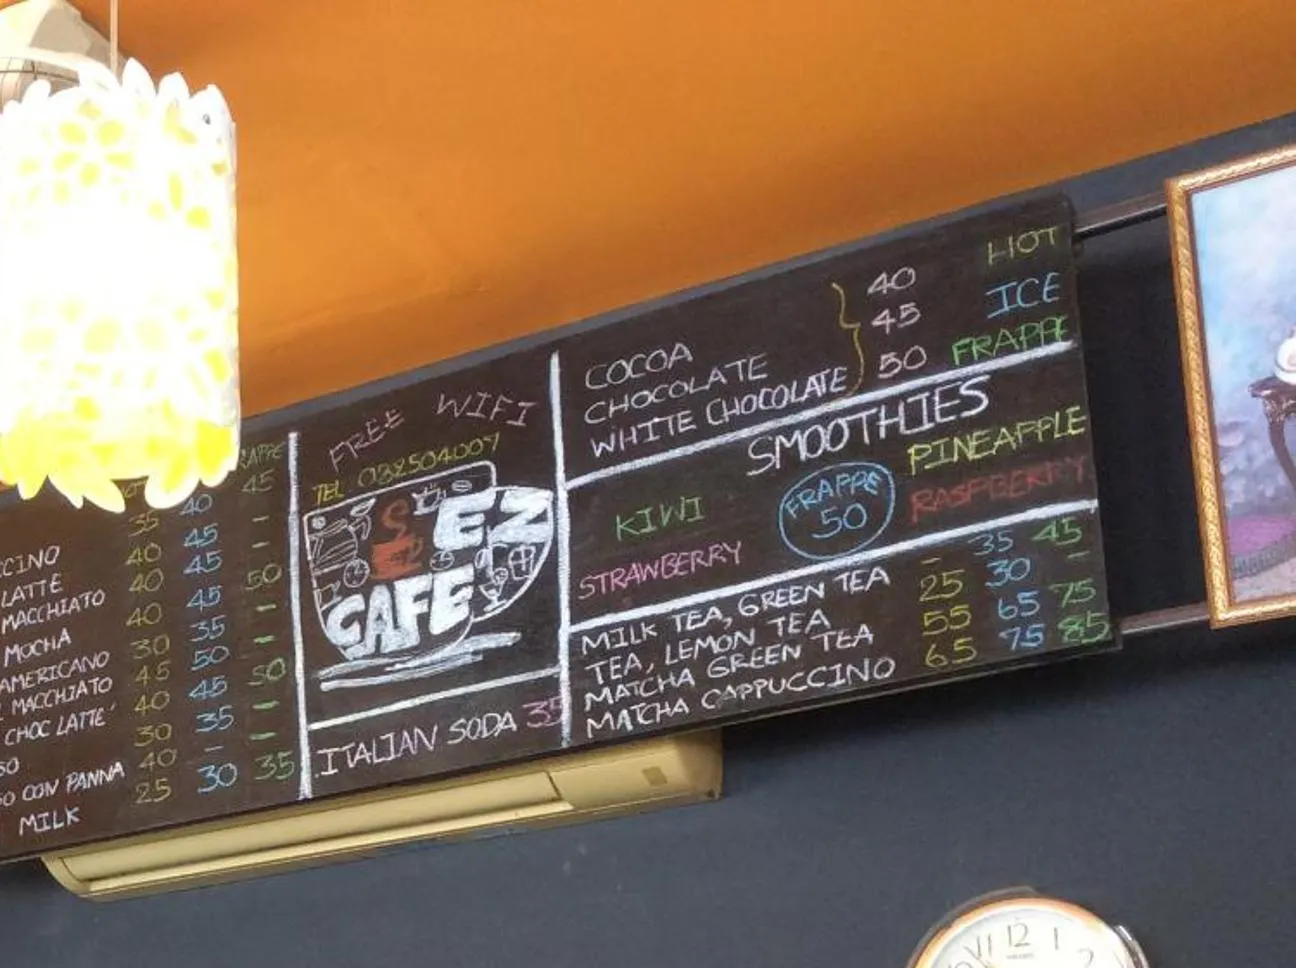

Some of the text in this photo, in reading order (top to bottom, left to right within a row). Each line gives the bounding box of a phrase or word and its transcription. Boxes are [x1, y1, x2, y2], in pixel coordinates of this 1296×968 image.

[986, 226, 1060, 266] HOT
[867, 267, 916, 295] 40
[985, 271, 1061, 320] ICE
[870, 302, 921, 335] 45
[584, 353, 769, 424] CHOCOLATE
[585, 342, 694, 390] COCOA
[877, 345, 927, 380] 50
[328, 391, 538, 473] FREE WIFI
[590, 366, 848, 458] WHITE CHOCOLATE
[746, 374, 992, 477] SMOOTHIES
[907, 405, 1088, 477] PINEAPPLE
[179, 493, 213, 516] 40
[241, 469, 275, 493] 45
[433, 487, 554, 551] EZ
[615, 496, 705, 542] KIWI
[783, 469, 883, 520] FRAPPE
[811, 502, 868, 540] 50
[1, 573, 63, 608] LATTE
[125, 542, 162, 566] 40
[183, 522, 219, 548] 45
[1, 589, 106, 634] MACCHIATO
[128, 567, 164, 592] 40
[183, 549, 223, 574] 45
[245, 563, 282, 591] 50
[577, 540, 742, 600] STRAWBERRY
[580, 623, 657, 655] MILK
[737, 581, 825, 618] GREEN
[832, 566, 891, 594] TEA
[967, 529, 1014, 556] 35
[1032, 516, 1083, 546] 45
[4, 628, 72, 668] MOCHA
[126, 603, 163, 627] 40
[186, 584, 222, 612] 45
[130, 634, 170, 659] 30
[189, 614, 227, 642] 35
[326, 563, 475, 660] CAFE
[664, 629, 756, 666] LEMON
[767, 608, 831, 637] TEA
[919, 568, 966, 602] 25
[984, 557, 1031, 587] 30
[583, 577, 1097, 712] MATCHA GREEN TEA 55 65 75
[4, 720, 51, 746] CHOC
[134, 691, 170, 717] 40
[188, 675, 228, 700] 45
[12, 677, 113, 716] MACCHIATO
[135, 660, 172, 686] 45
[191, 645, 230, 671] 50
[247, 657, 286, 686] 50
[585, 698, 689, 739] MATCHA
[701, 657, 896, 710] CAPPUCCINO
[924, 636, 978, 668] 65
[998, 623, 1046, 651] 75
[134, 723, 172, 747] 30
[195, 705, 234, 732] 35
[317, 724, 439, 776] ITALIAN
[447, 711, 518, 745] SODA
[18, 805, 81, 837] MILK
[135, 778, 172, 804] 25
[197, 763, 238, 794] 30
[254, 751, 296, 781] 35
[66, 761, 125, 793] PANNA
[139, 749, 177, 772] 40
[977, 934, 992, 957] 11
[1007, 923, 1030, 947] 12
